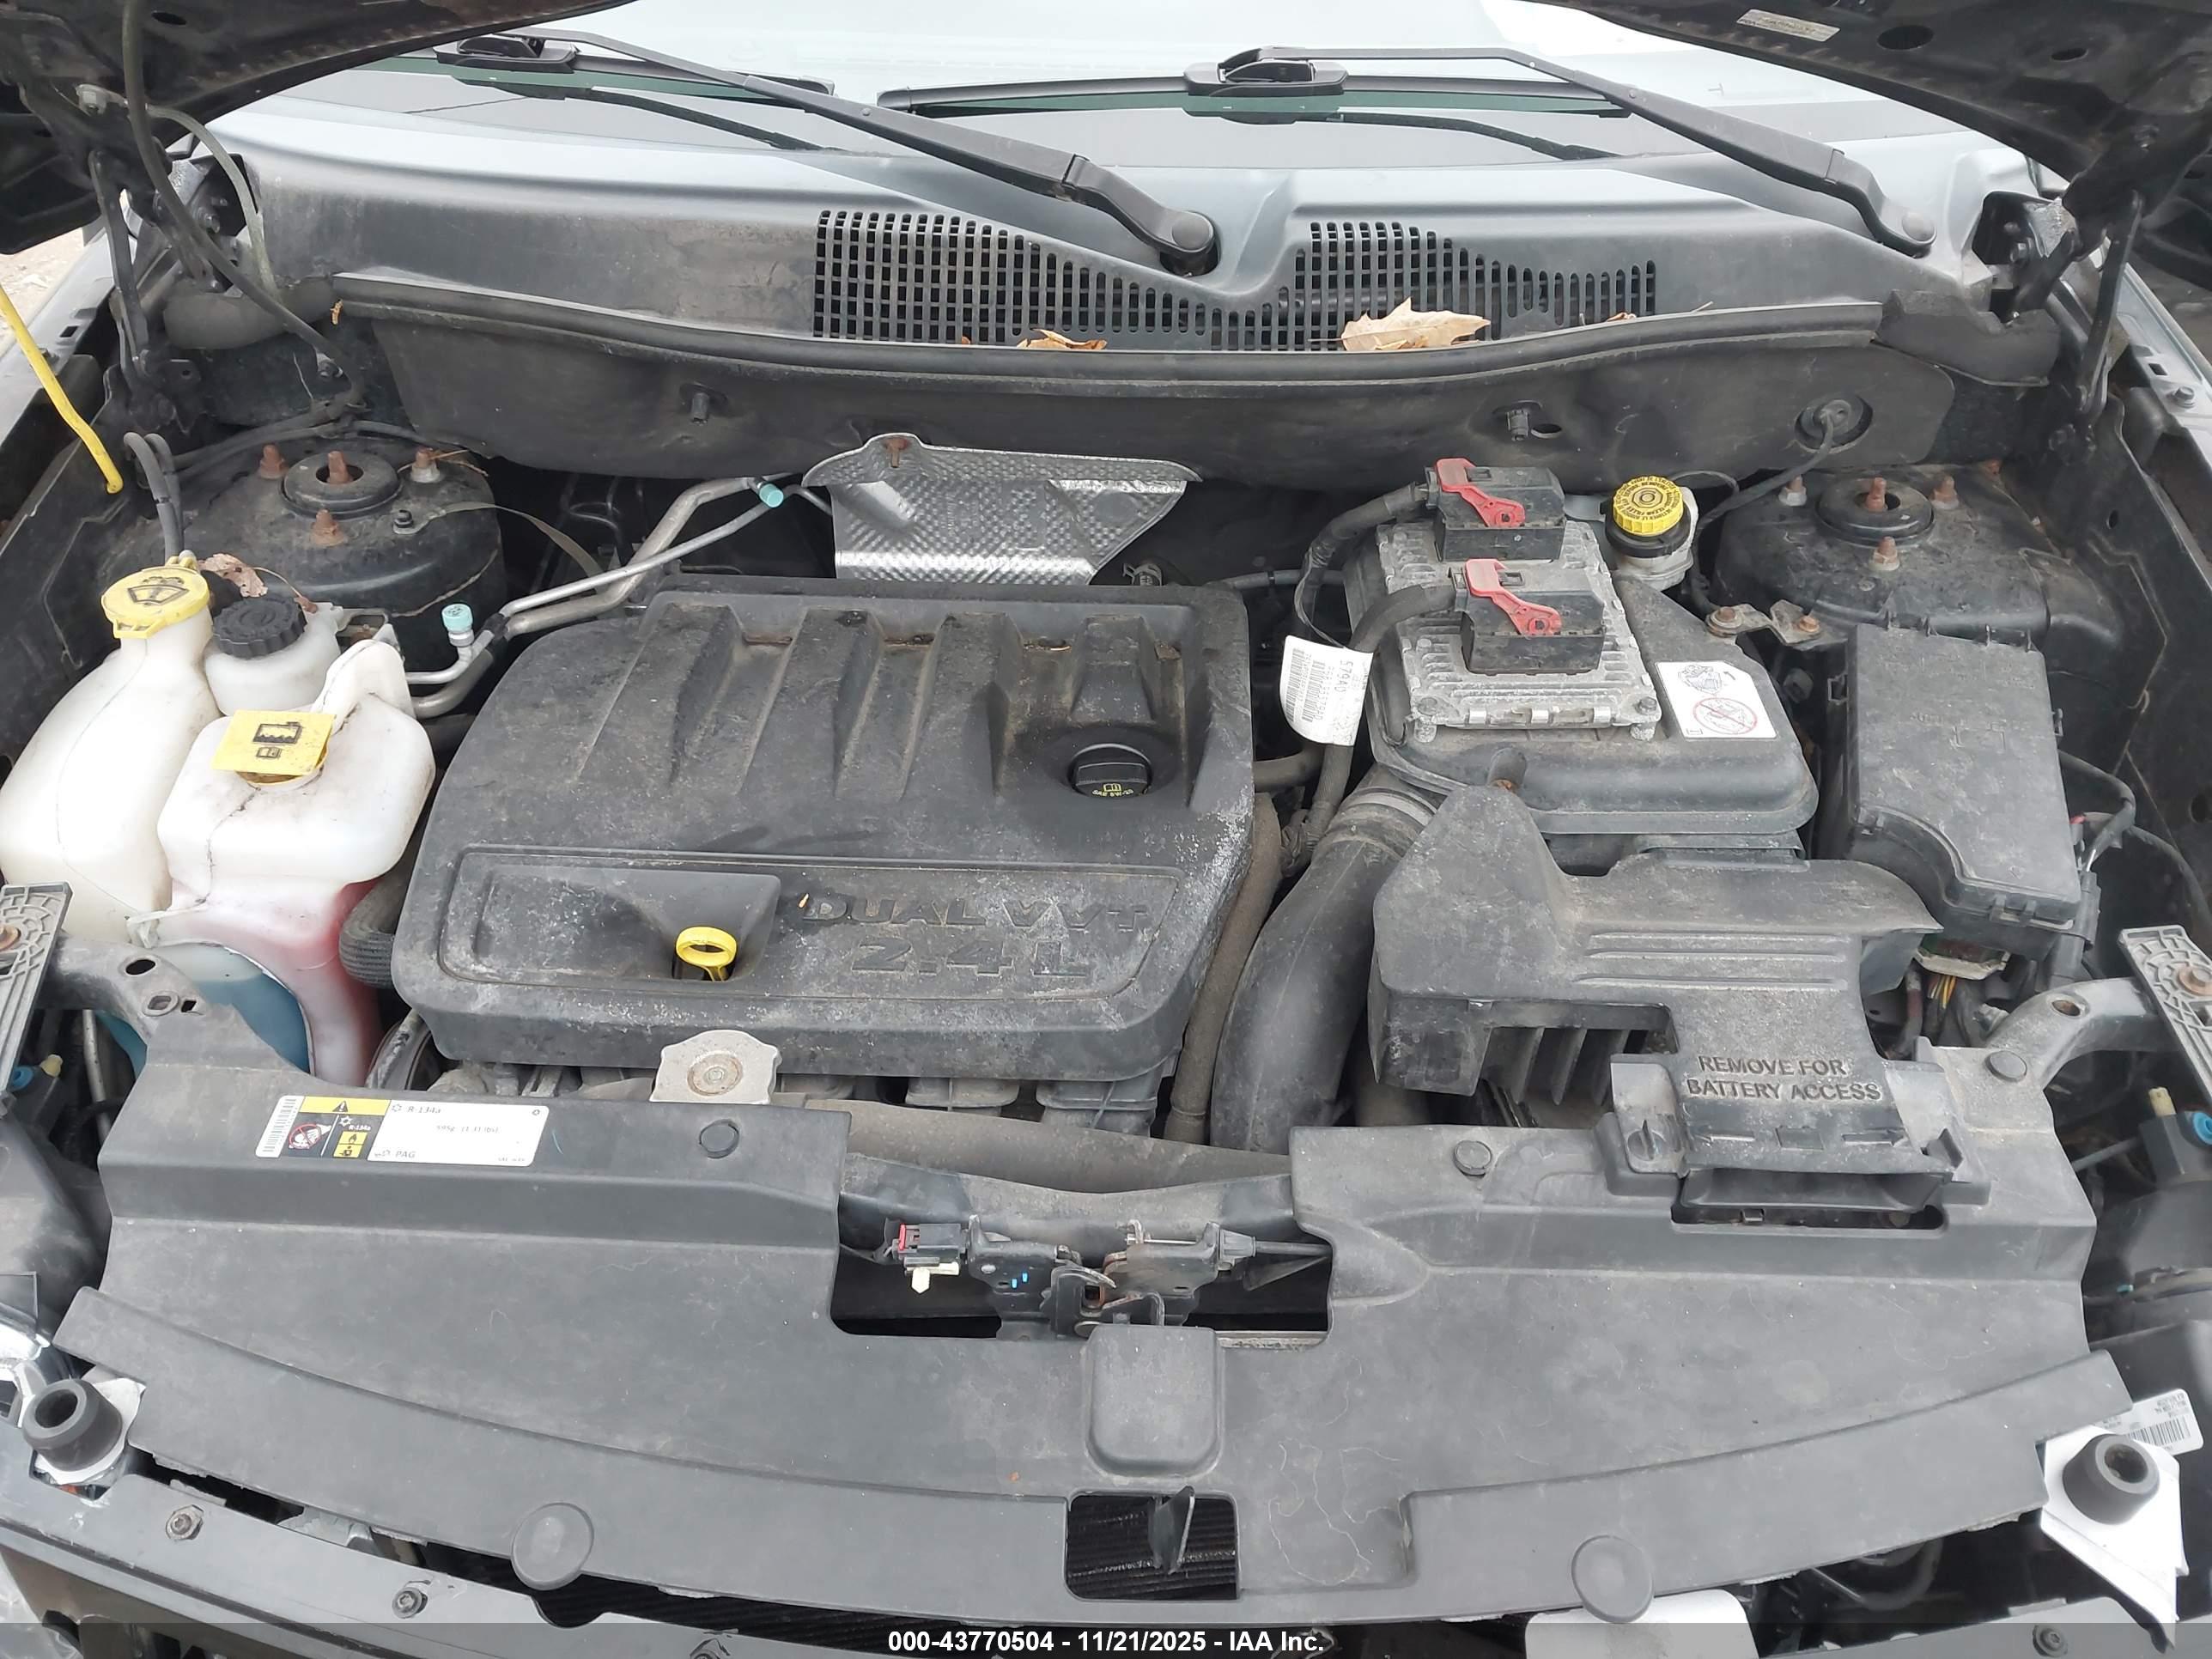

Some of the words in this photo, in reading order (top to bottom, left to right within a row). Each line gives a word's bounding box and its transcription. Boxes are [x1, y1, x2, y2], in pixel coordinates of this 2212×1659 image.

[802, 896, 988, 927] DUAL
[1002, 898, 1149, 932] VVT
[1698, 1055, 1796, 1076] REMOVE
[1799, 1058, 1848, 1077] FOR
[1686, 1079, 1782, 1099] BATTERY
[1791, 1083, 1882, 1101] ACCESS
[407, 1105, 441, 1115] R-134a
[395, 1150, 416, 1159] PAG
